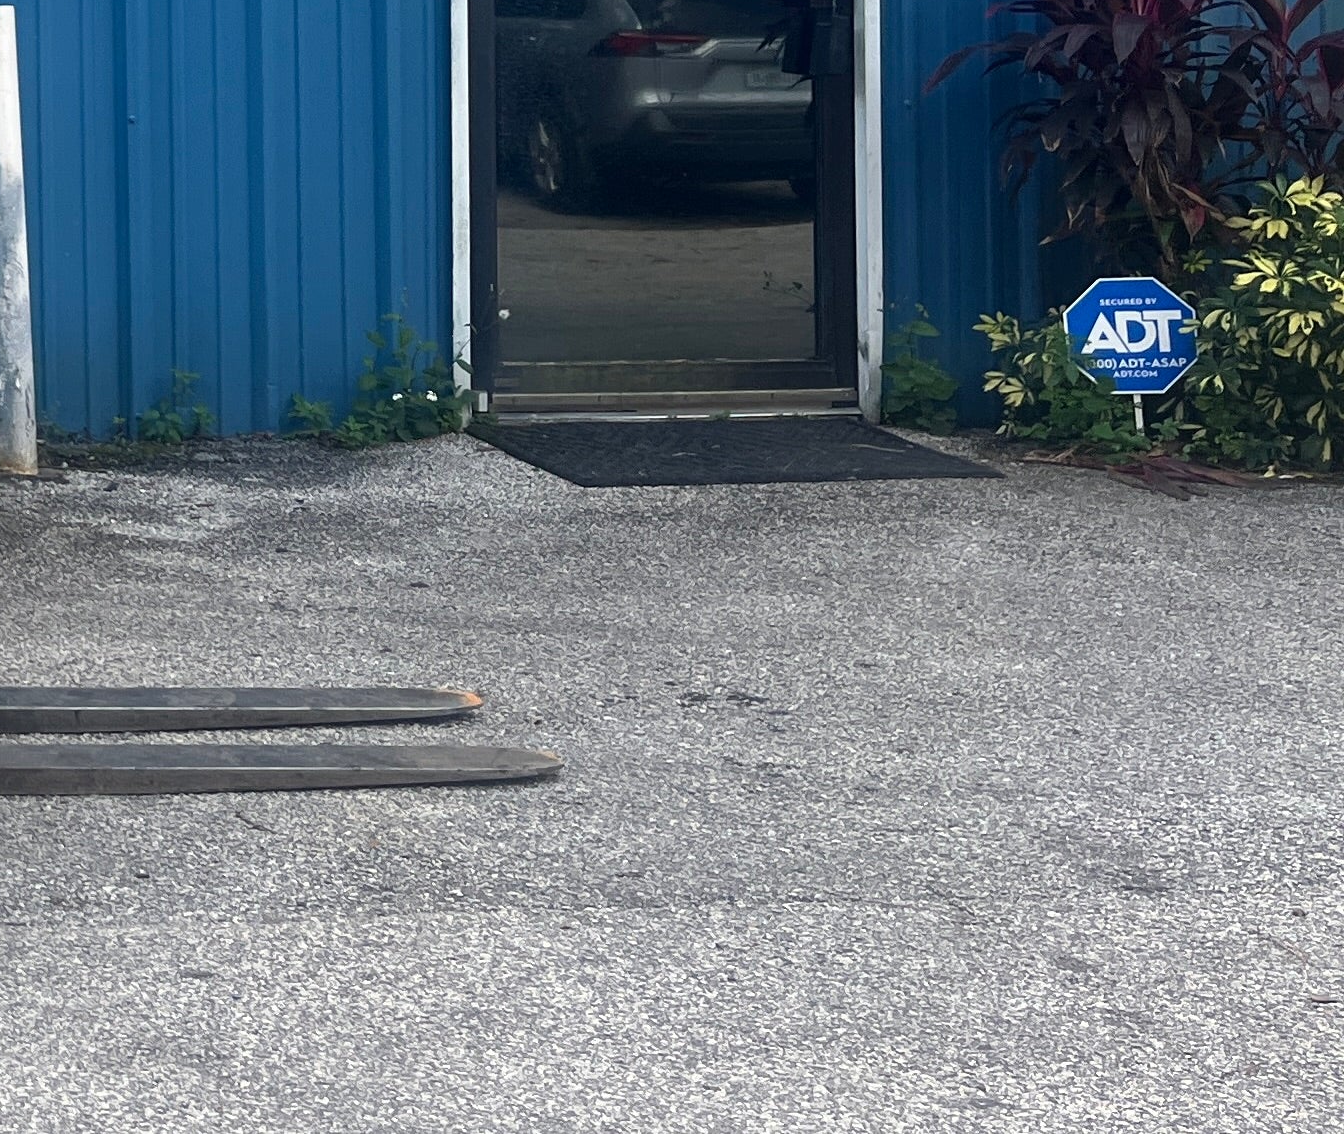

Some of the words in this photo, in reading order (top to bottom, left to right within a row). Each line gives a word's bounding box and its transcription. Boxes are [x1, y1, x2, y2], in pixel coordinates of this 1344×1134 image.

[1099, 298, 1143, 307] SECURED
[1145, 297, 1157, 305] BY
[1081, 309, 1182, 354] ADT
[1119, 357, 1187, 368] ADT-ASAP
[1113, 370, 1158, 378] ADT.COM
